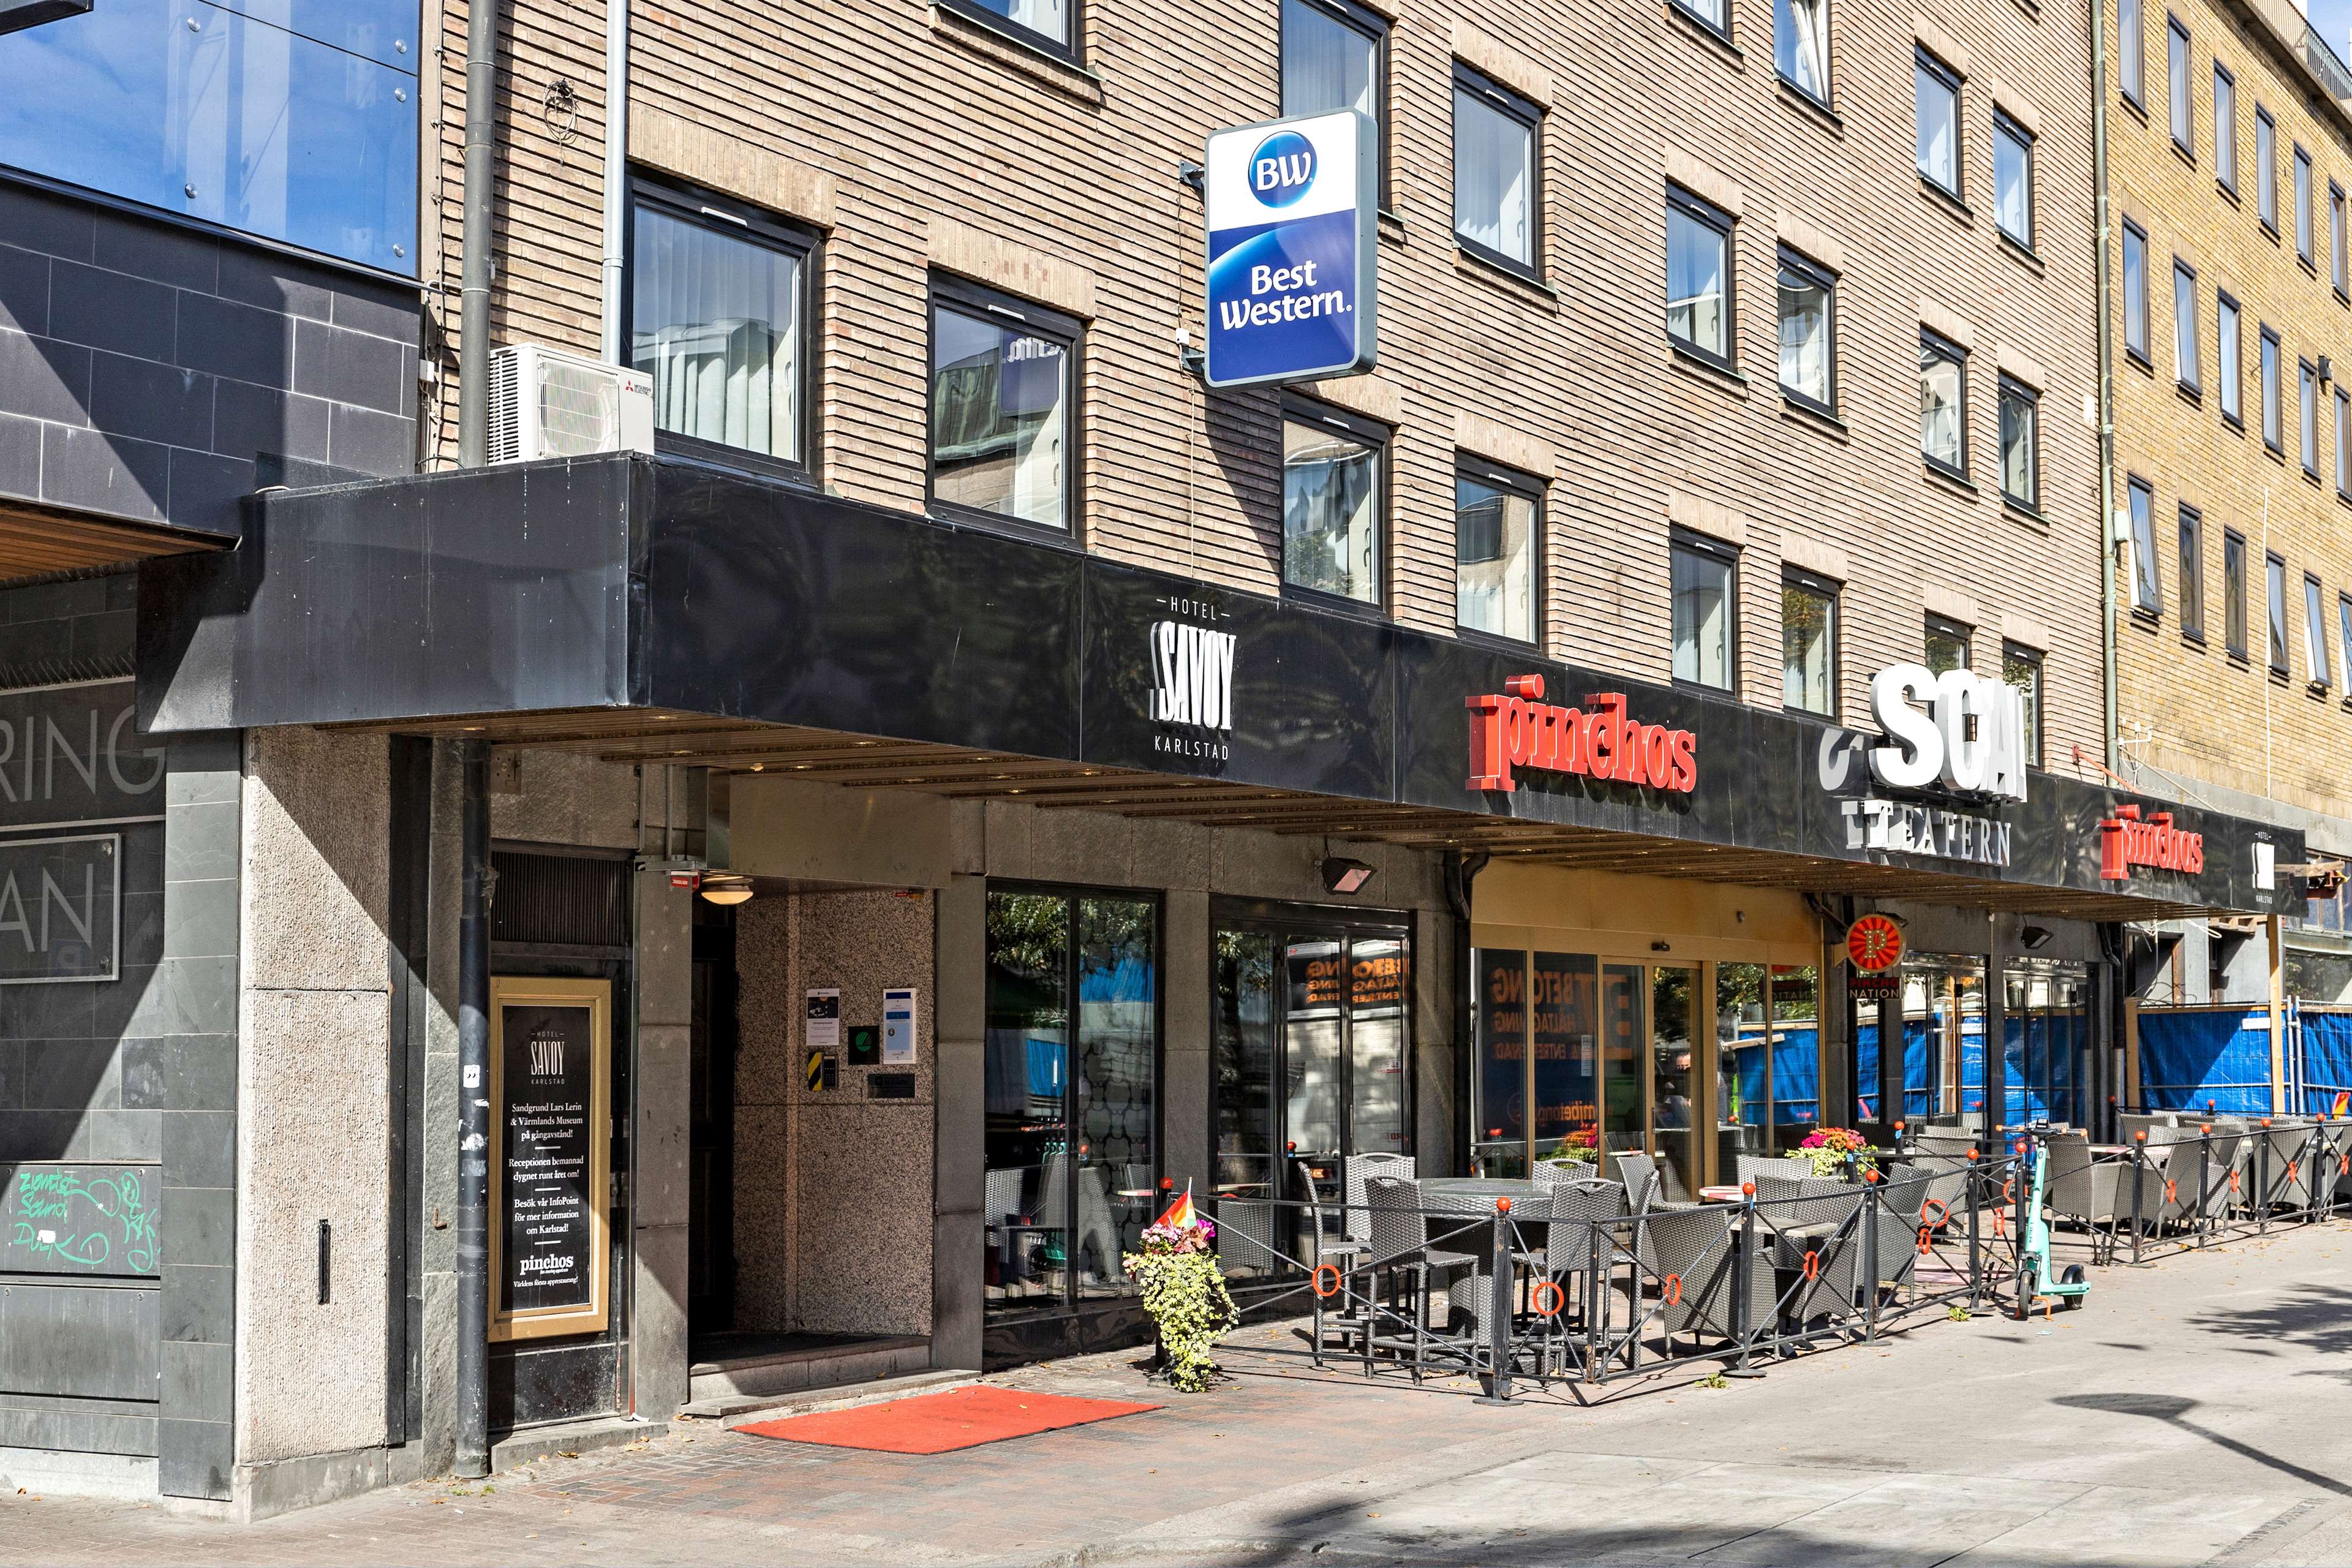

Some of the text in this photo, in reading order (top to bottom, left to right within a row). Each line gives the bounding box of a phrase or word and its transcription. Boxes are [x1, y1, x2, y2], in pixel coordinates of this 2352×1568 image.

[1256, 151, 1311, 190] BW
[1251, 260, 1317, 295] Best
[1171, 596, 1216, 620] HOTEL
[1159, 620, 1237, 730] SAVOY
[1480, 673, 1697, 793] pinchos
[1155, 736, 1228, 760] KARLSTAD
[1849, 989, 1899, 998] NATION
[530, 1041, 565, 1076] SAVOY
[511, 1102, 582, 1114] Sandgrund Lars Lerin
[518, 1116, 555, 1125] Värmlands
[556, 1116, 583, 1125] Museum
[521, 1129, 573, 1141] på gångavstånd!
[508, 1155, 584, 1169] Receptionen bemannad
[513, 1171, 537, 1183] dygnet
[554, 1169, 566, 1178] året
[567, 1169, 579, 1178] om!
[514, 1196, 579, 1208] Besök vår InfoPoint
[514, 1212, 525, 1222] för
[541, 1210, 579, 1220] information
[539, 1223, 569, 1234] Karlstad!
[519, 1254, 574, 1276] pinchos
[513, 1279, 533, 1287] Världens
[547, 1276, 578, 1286] apprestaurang!
